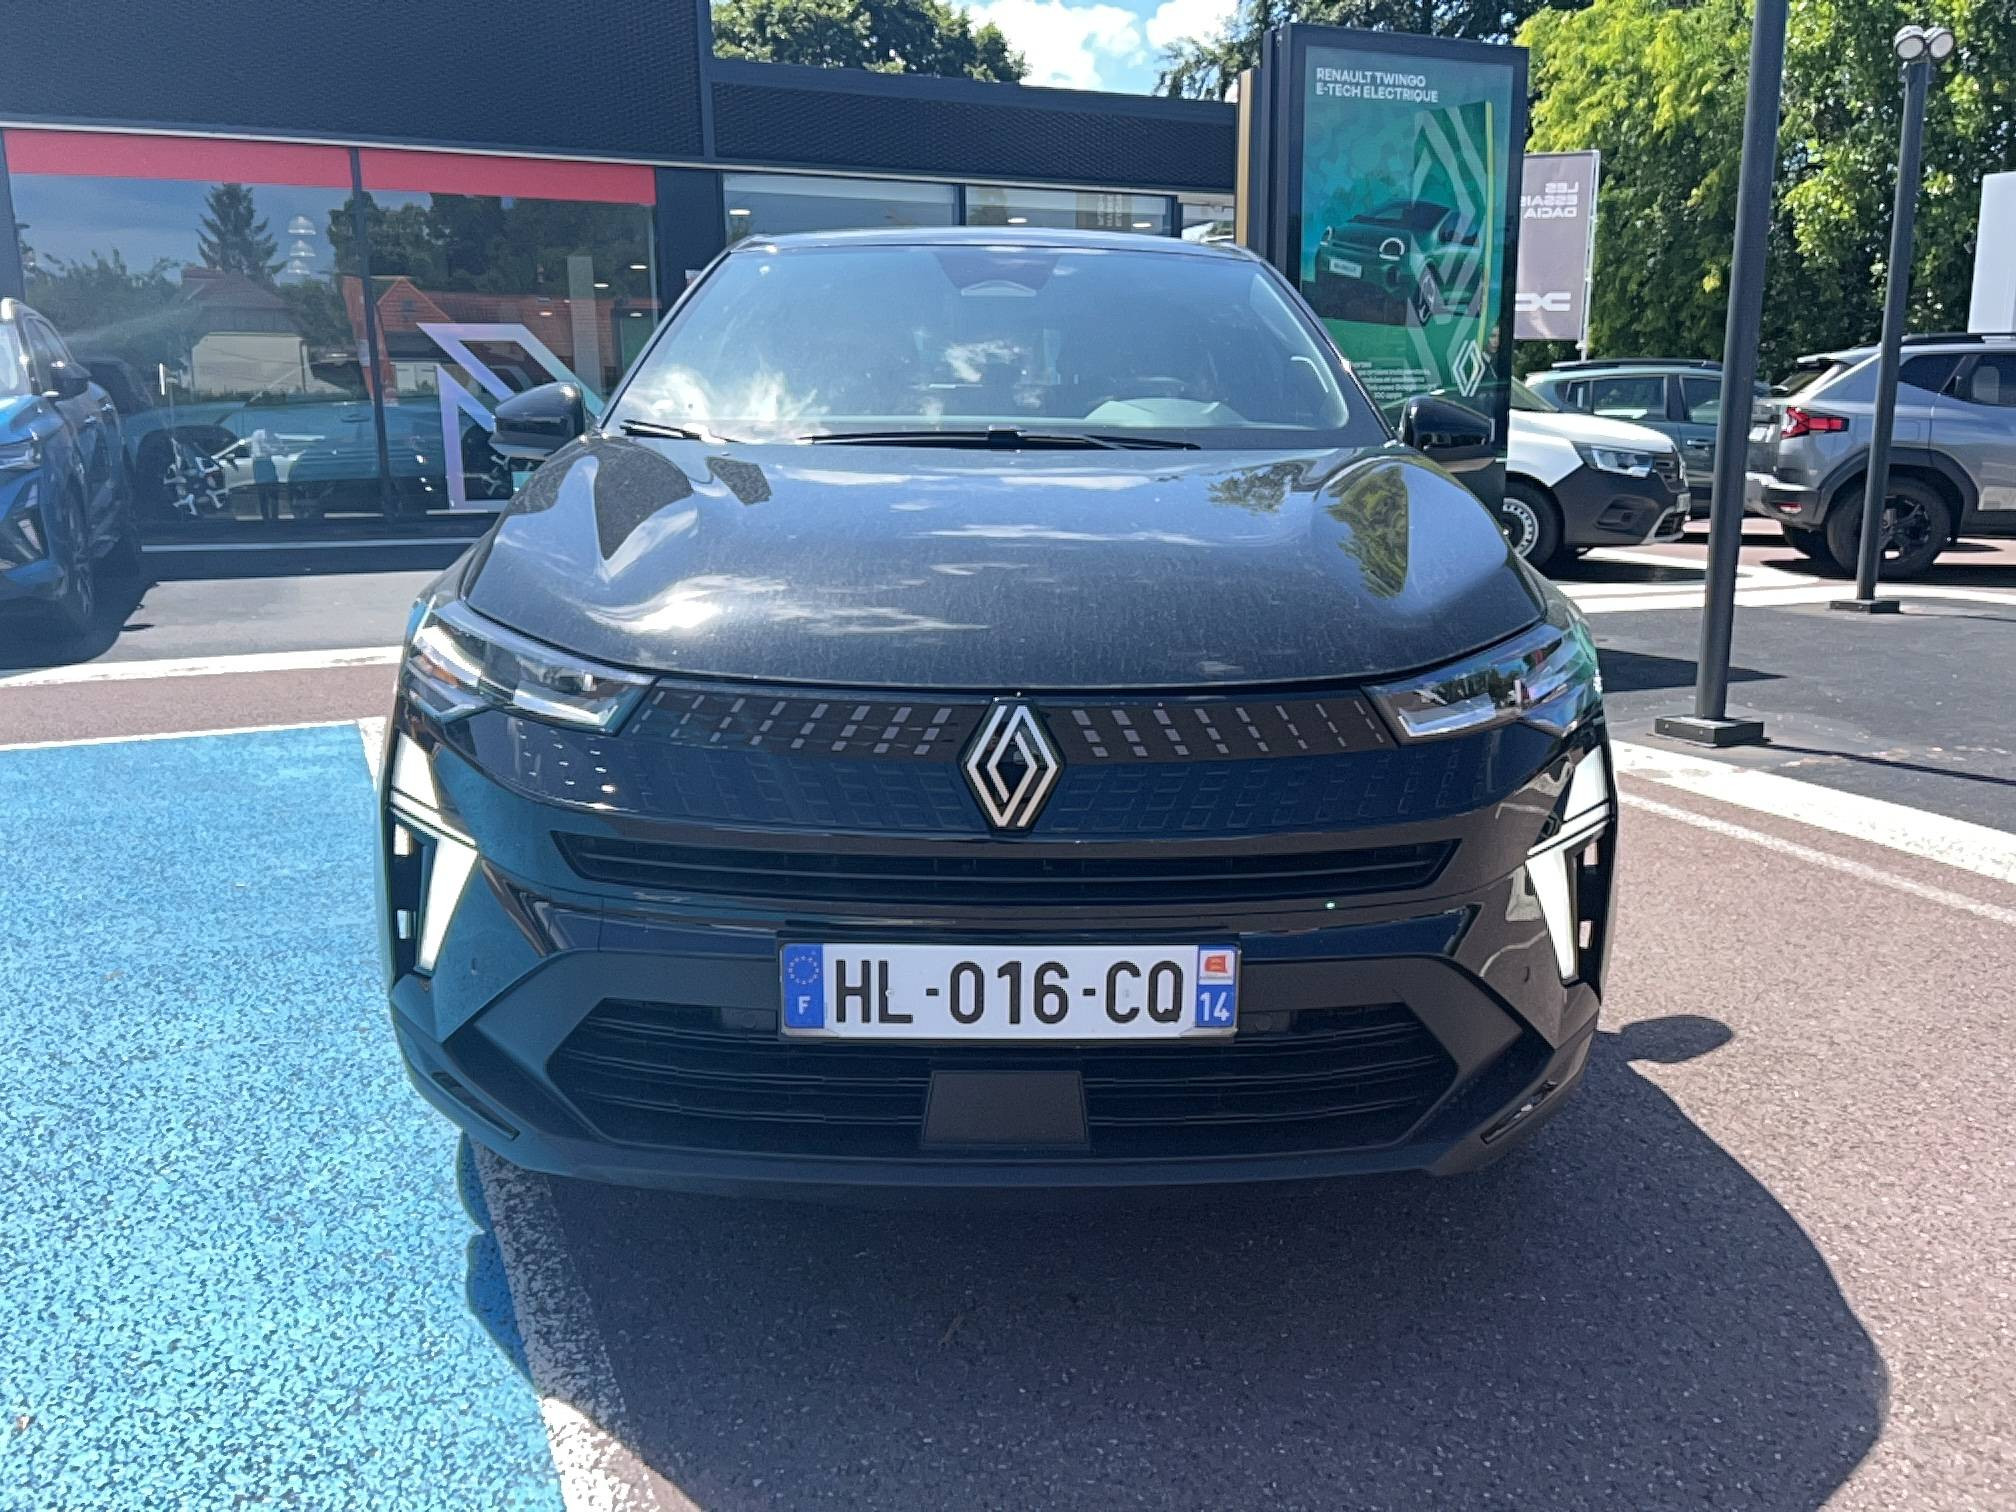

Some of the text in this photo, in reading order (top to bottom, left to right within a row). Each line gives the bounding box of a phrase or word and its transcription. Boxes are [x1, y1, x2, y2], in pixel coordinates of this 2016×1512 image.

[1316, 67, 1426, 88] RENAULT TWINGO
[1316, 82, 1438, 103] E-TECH ELECTRIQUE
[798, 995, 811, 1015] F
[1200, 991, 1230, 1022] 14
